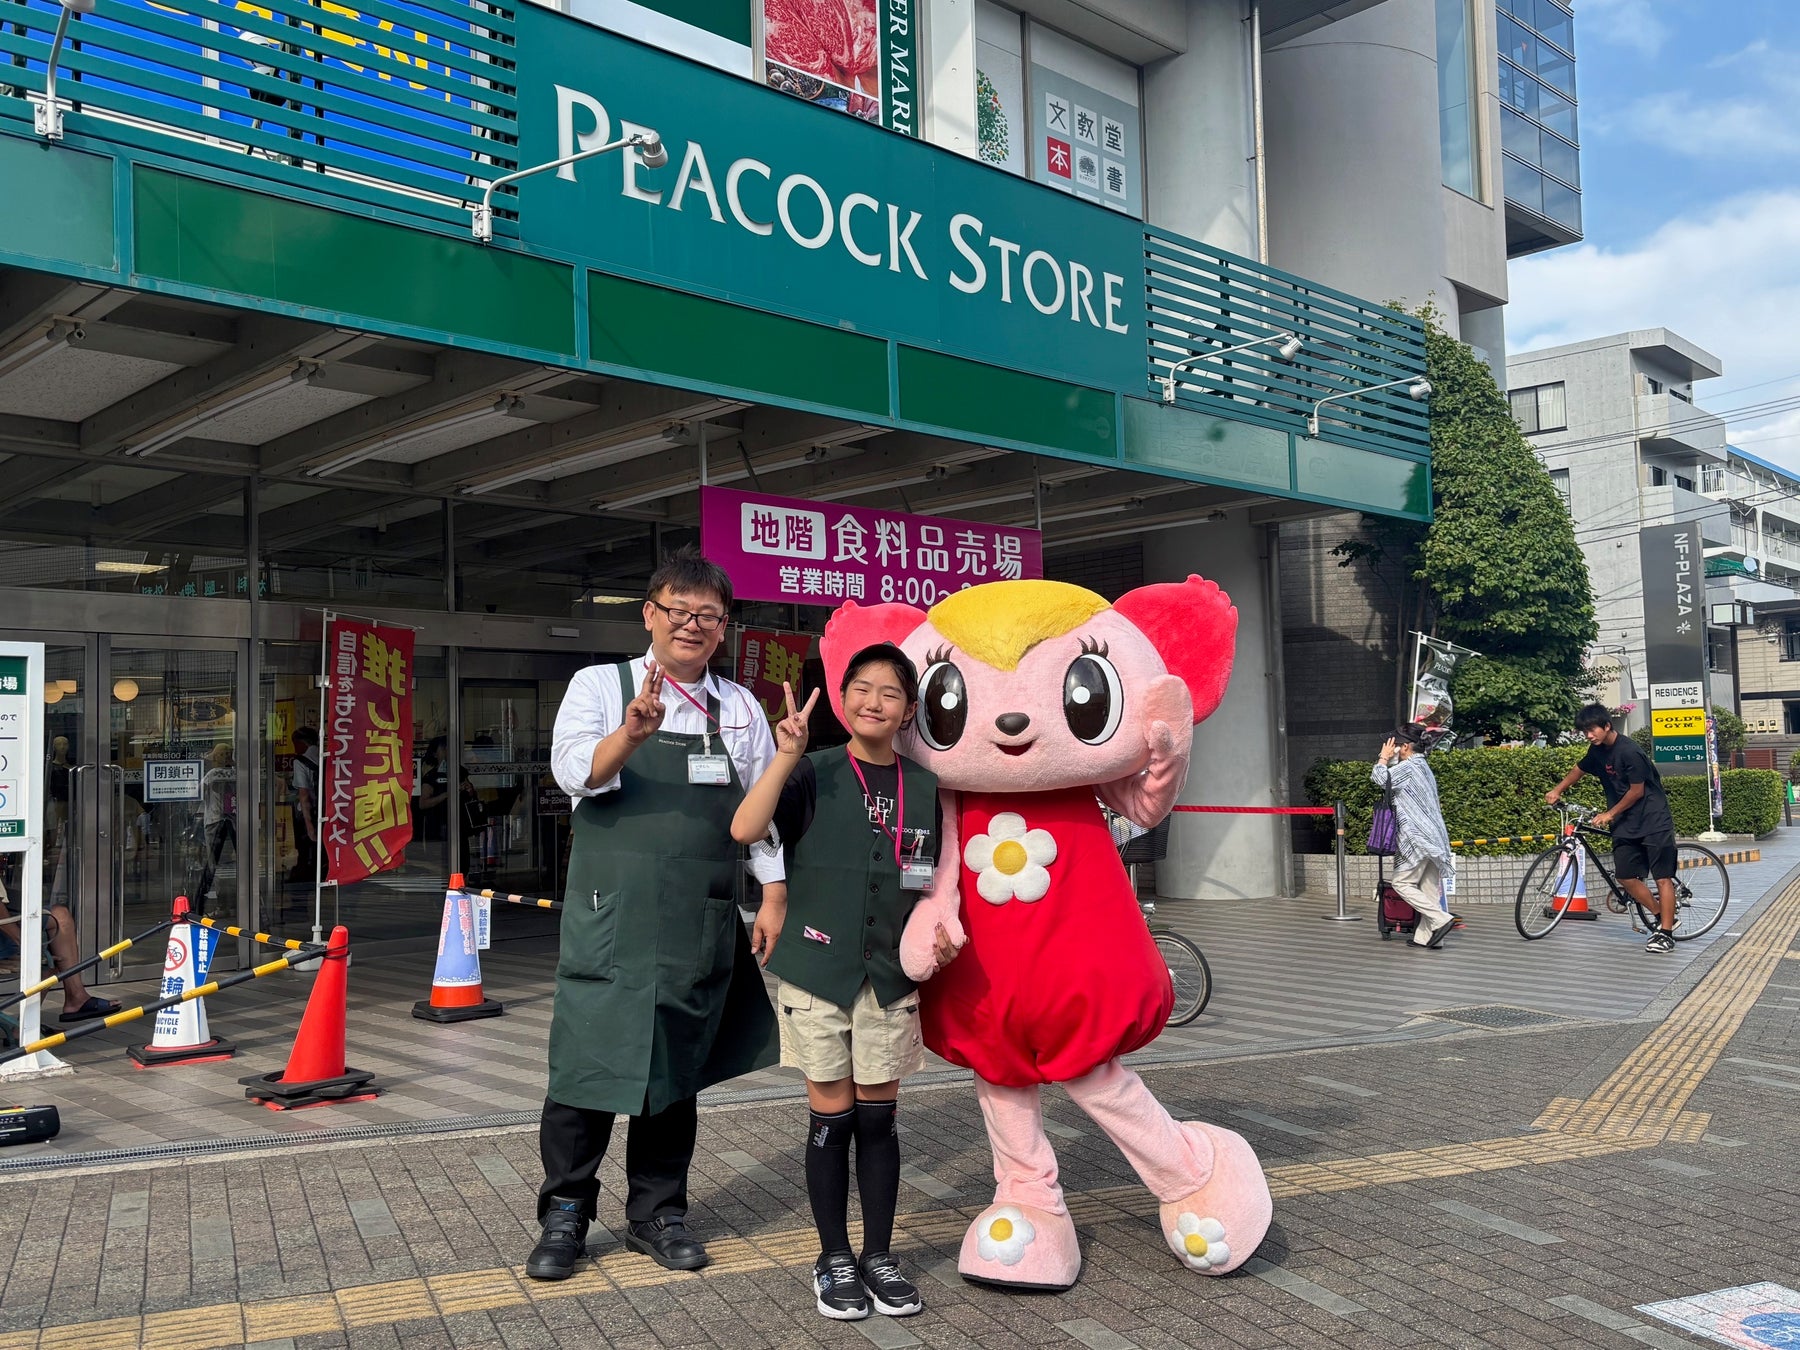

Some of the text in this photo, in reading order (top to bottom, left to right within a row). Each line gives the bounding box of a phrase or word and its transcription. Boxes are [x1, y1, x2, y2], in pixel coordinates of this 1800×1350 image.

[1049, 101, 1122, 152] 文教堂
[1050, 144, 1123, 193] 本 書
[554, 84, 1129, 335] PEACOCK STORE
[750, 510, 1023, 580] 地階 食料品売場
[779, 565, 866, 600] 営業時間
[1673, 532, 1693, 616] NF-PLAZA
[0, 676, 18, 690] 場
[1655, 715, 1702, 723] GOLD'S
[1655, 743, 1703, 752] PEACOCK STORE
[154, 765, 194, 779] 閉鎖中
